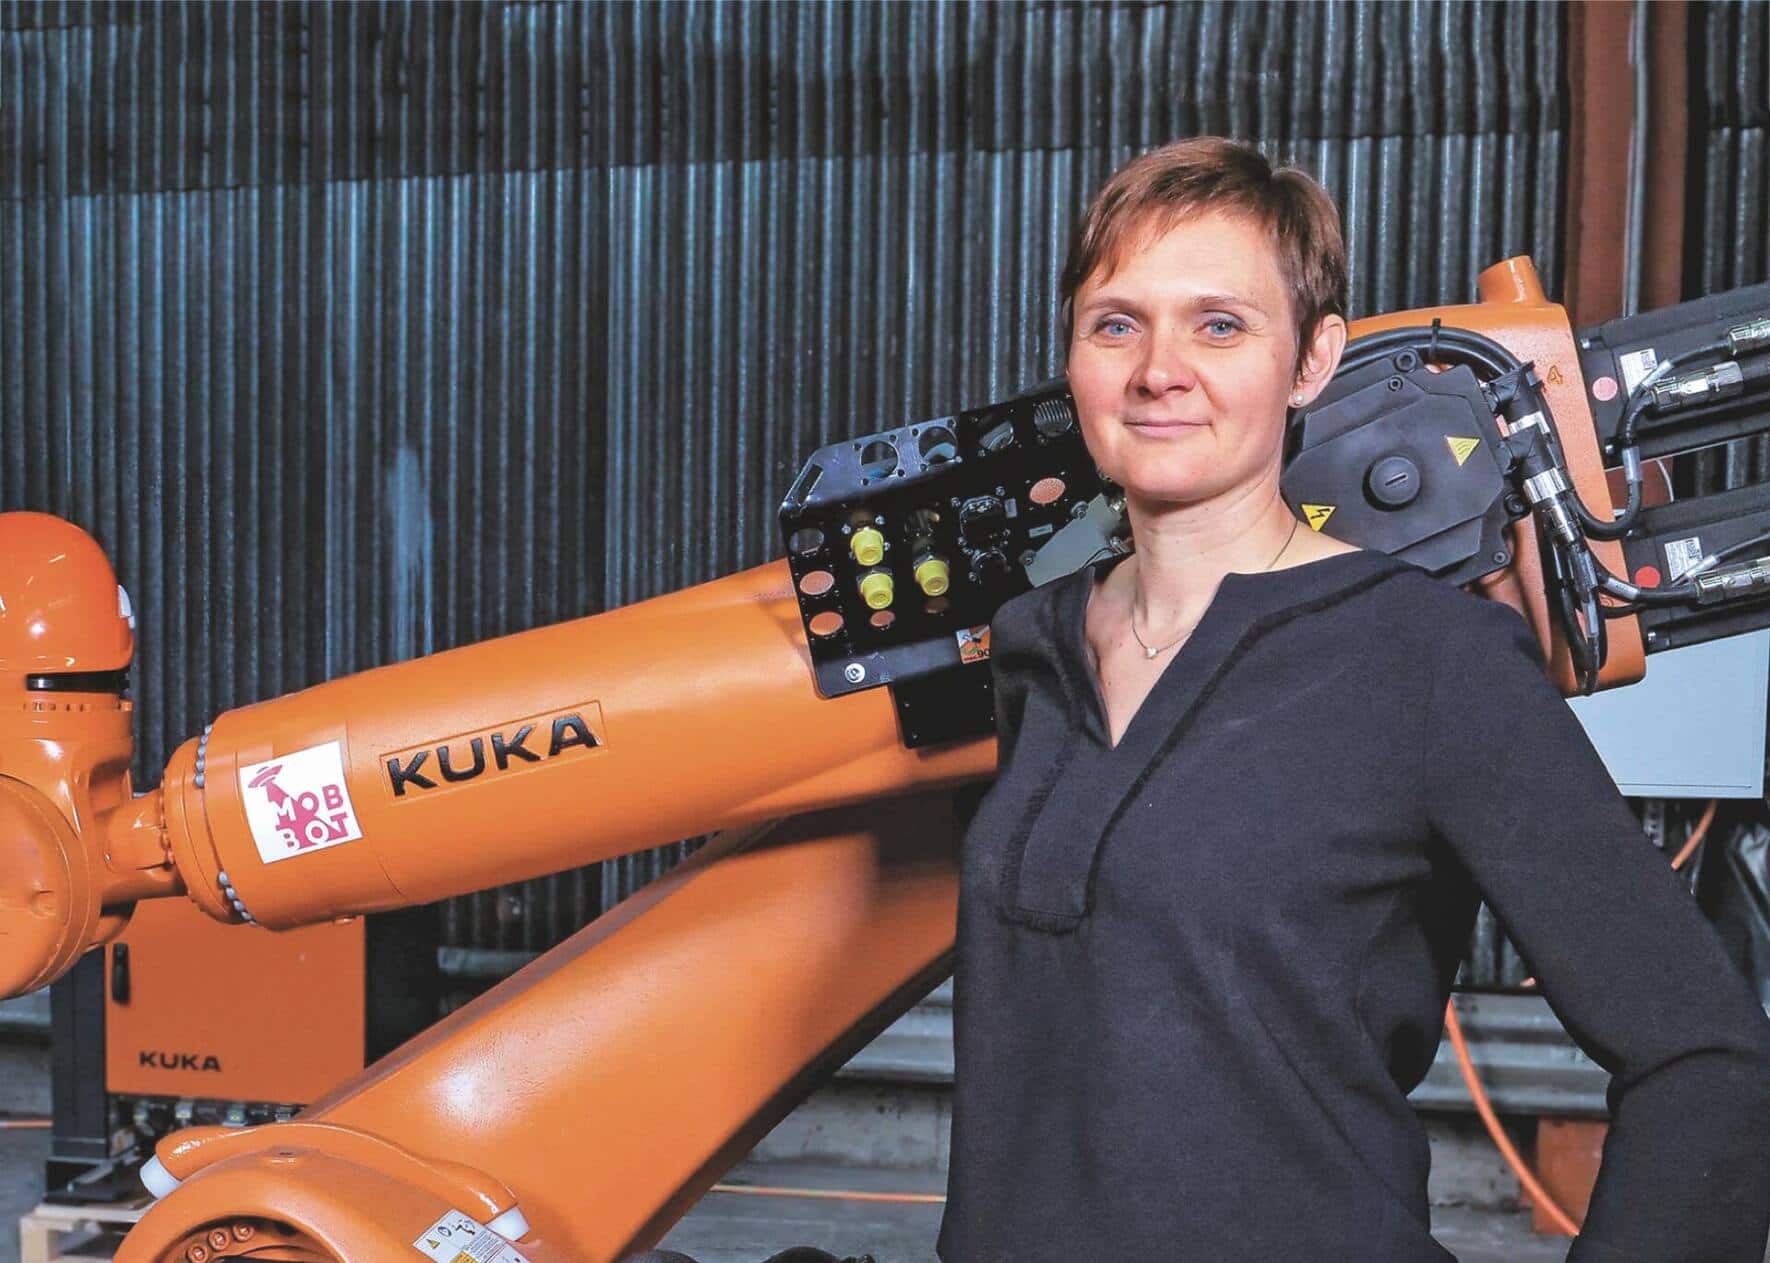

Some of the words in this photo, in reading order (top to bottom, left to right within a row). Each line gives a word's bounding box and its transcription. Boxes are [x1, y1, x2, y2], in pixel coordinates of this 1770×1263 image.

[387, 713, 600, 797] KUKA
[275, 784, 344, 822] MOB
[278, 811, 348, 850] BOT
[138, 1051, 222, 1072] KUKA
